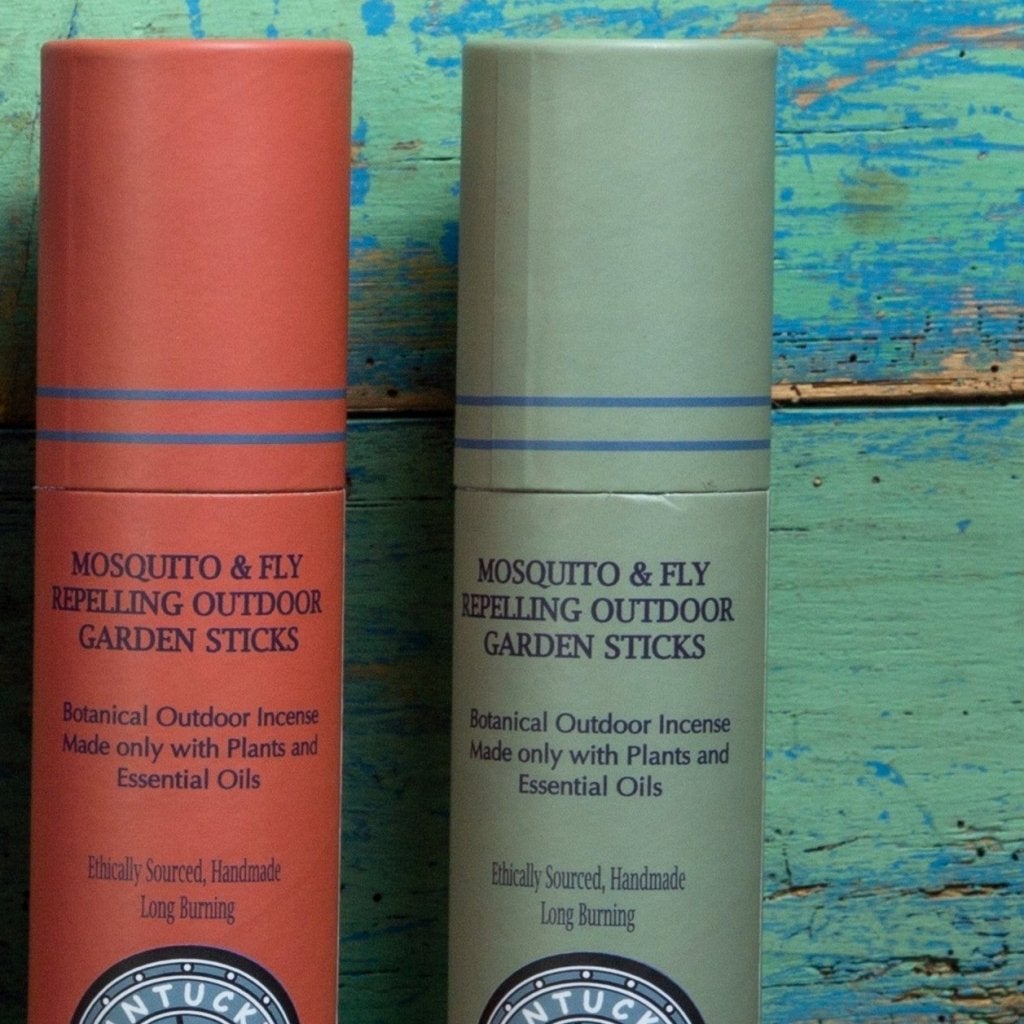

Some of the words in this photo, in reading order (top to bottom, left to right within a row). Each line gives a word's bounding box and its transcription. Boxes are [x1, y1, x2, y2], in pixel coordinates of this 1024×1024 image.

[71, 551, 222, 582] MOSQUITO
[230, 555, 252, 580] &
[259, 554, 303, 580] FLY
[477, 558, 620, 589] MOSQUITO
[629, 561, 653, 587] &
[659, 561, 711, 586] FLY
[51, 585, 184, 616] REPELLING
[192, 589, 322, 616] OUTDOOR
[462, 592, 582, 622] REPELLING
[591, 597, 735, 624] OUTDOOR
[79, 624, 197, 652] GARDEN
[206, 626, 299, 653] STICKS
[484, 630, 595, 659] GARDEN
[604, 634, 706, 660] STICKS
[470, 708, 547, 732] Botanical
[555, 712, 652, 734] Outdoor
[660, 714, 731, 734] Incense
[470, 739, 512, 762] Made
[518, 742, 563, 770] only
[569, 743, 618, 765] with
[627, 744, 691, 765] Plants
[697, 742, 729, 765] and
[519, 774, 607, 796] Essential
[616, 775, 663, 797] Oils
[492, 861, 542, 893] Ethically
[546, 865, 605, 894] Sourced,
[610, 865, 686, 891] Handmade
[541, 901, 574, 931] Long
[578, 903, 635, 933] Burning
